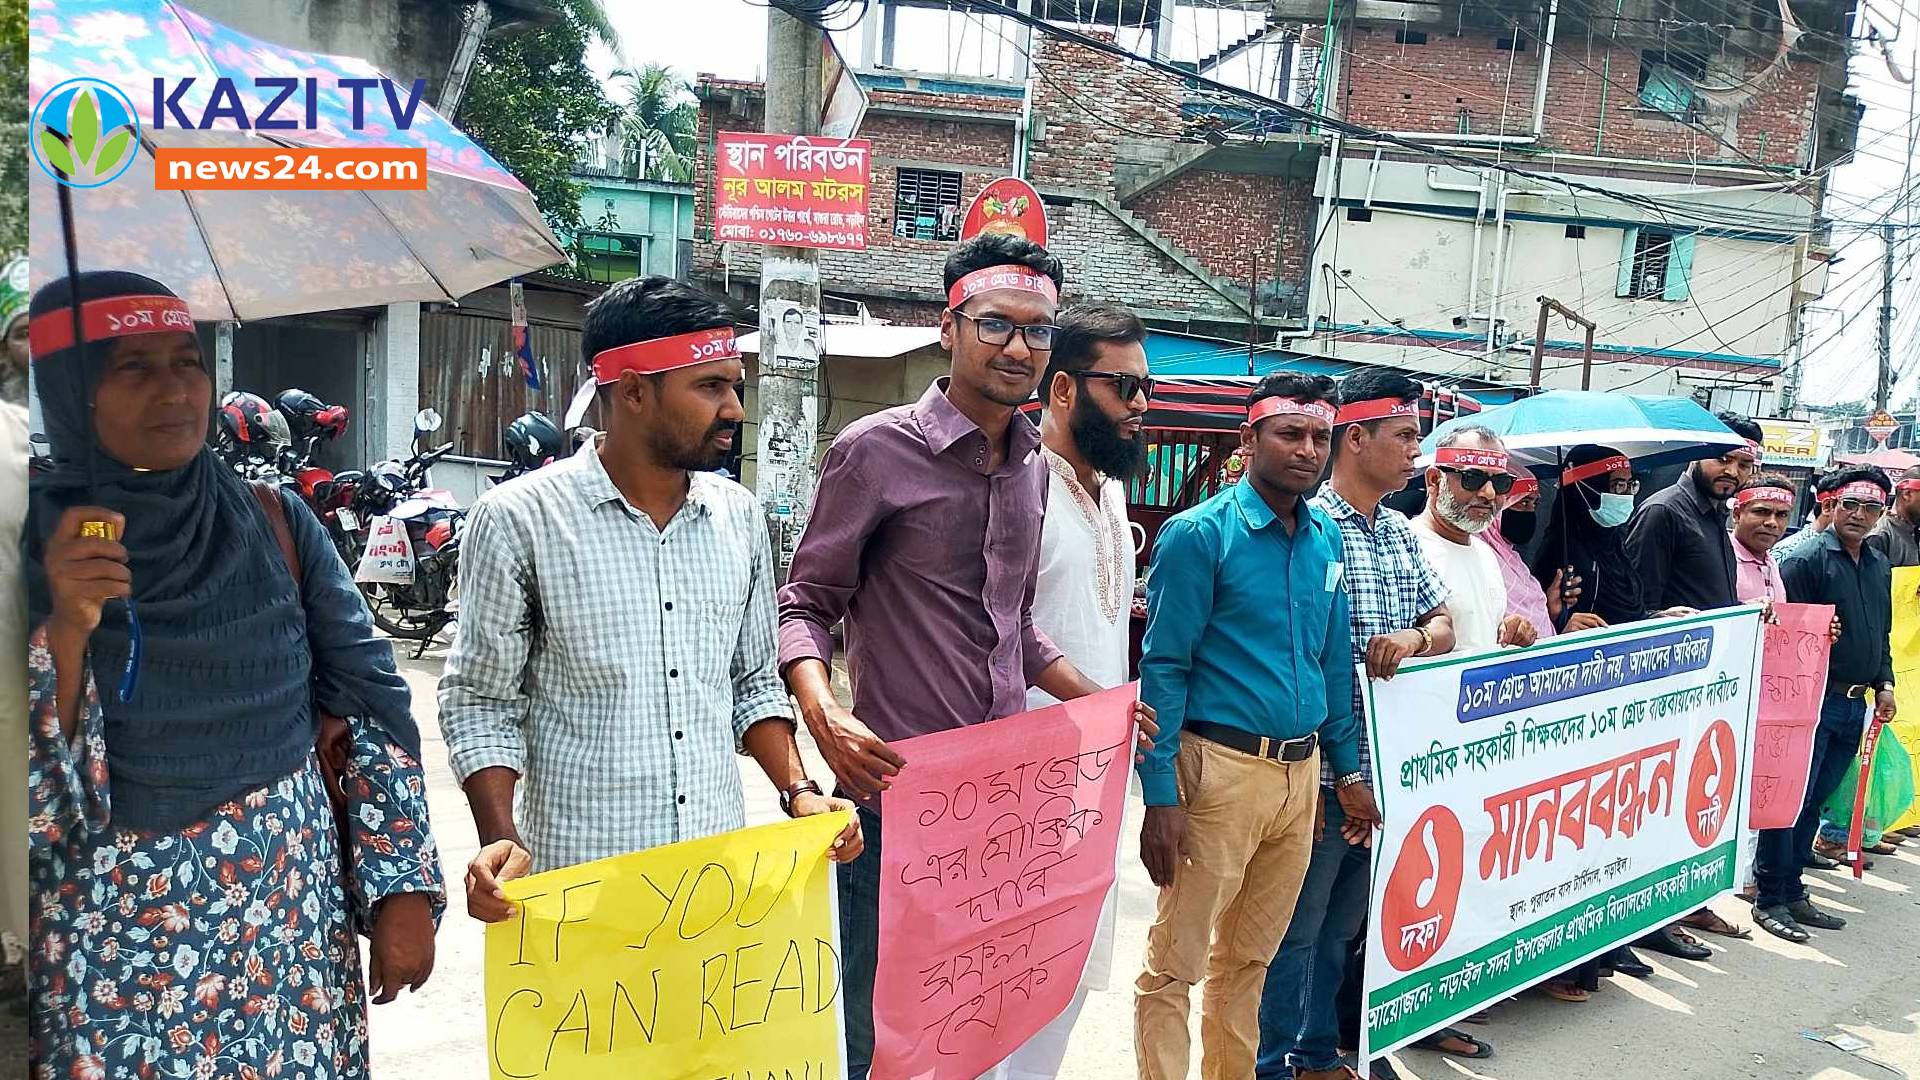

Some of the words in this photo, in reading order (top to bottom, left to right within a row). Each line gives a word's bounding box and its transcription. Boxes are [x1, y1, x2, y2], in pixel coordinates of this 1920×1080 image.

[724, 140, 768, 175] স্থান
[774, 136, 866, 175] পরিবর্তন
[754, 177, 807, 201] আলম
[811, 174, 865, 204] মটরস
[962, 276, 986, 298] ১০ম
[991, 273, 1020, 286] গ্রেড
[106, 310, 154, 331] ১০ম
[690, 338, 724, 359] ১০ম
[1276, 401, 1298, 411] ১০ম
[1303, 403, 1324, 416] গ্রেড
[1455, 454, 1475, 463] ১০ম
[1477, 455, 1497, 466] গ্রেড
[1605, 461, 1622, 470] ১০ম
[1764, 445, 1810, 455] NER
[1463, 681, 1496, 712] ১০ম
[1498, 673, 1527, 704] গ্রেড
[1529, 664, 1580, 697] আমাদের
[1581, 649, 1605, 687] দাবী
[1607, 655, 1625, 684] নয়,
[1629, 645, 1672, 675] আমাদের
[1674, 634, 1710, 665] অধিকার
[1400, 740, 1459, 792] প্রাথমিক
[1463, 720, 1517, 772] সহকারী
[1522, 714, 1586, 760] শিক্ষকদের
[1590, 707, 1618, 738] ১০ম
[1622, 699, 1647, 730] গ্রেড
[1650, 686, 1704, 722] বাস্তবায়নের
[1706, 671, 1740, 707] দাবীতে
[1703, 729, 1722, 798] ১
[919, 762, 1037, 827] ১০ম
[1035, 740, 1127, 794] গ্রেড
[1479, 738, 1680, 882] মানববন্ধন
[901, 848, 968, 888] এর
[981, 795, 1103, 878] যৌক্তিক
[1697, 799, 1723, 838] দাবী
[955, 851, 1078, 922] দাবি
[1415, 819, 1440, 909] ১
[1530, 887, 1557, 914] পুরাতন
[1558, 880, 1573, 898] বাস
[1573, 867, 1601, 892] টার্মিনাল,
[510, 880, 601, 966] IF
[626, 850, 797, 949] YOU
[1400, 912, 1443, 958] দফা
[1438, 958, 1484, 1001] নড়াইল
[1486, 949, 1513, 978] সদর
[1515, 922, 1564, 966] উপজেলার
[1566, 903, 1606, 943] প্রাথমিক
[1606, 884, 1653, 926] বিদ্যালয়ের
[1655, 864, 1690, 903] সহকারী
[919, 905, 1078, 1003] সফল
[494, 968, 662, 1079] CAN
[699, 937, 842, 1040] READ
[923, 939, 1083, 1055] হোক
